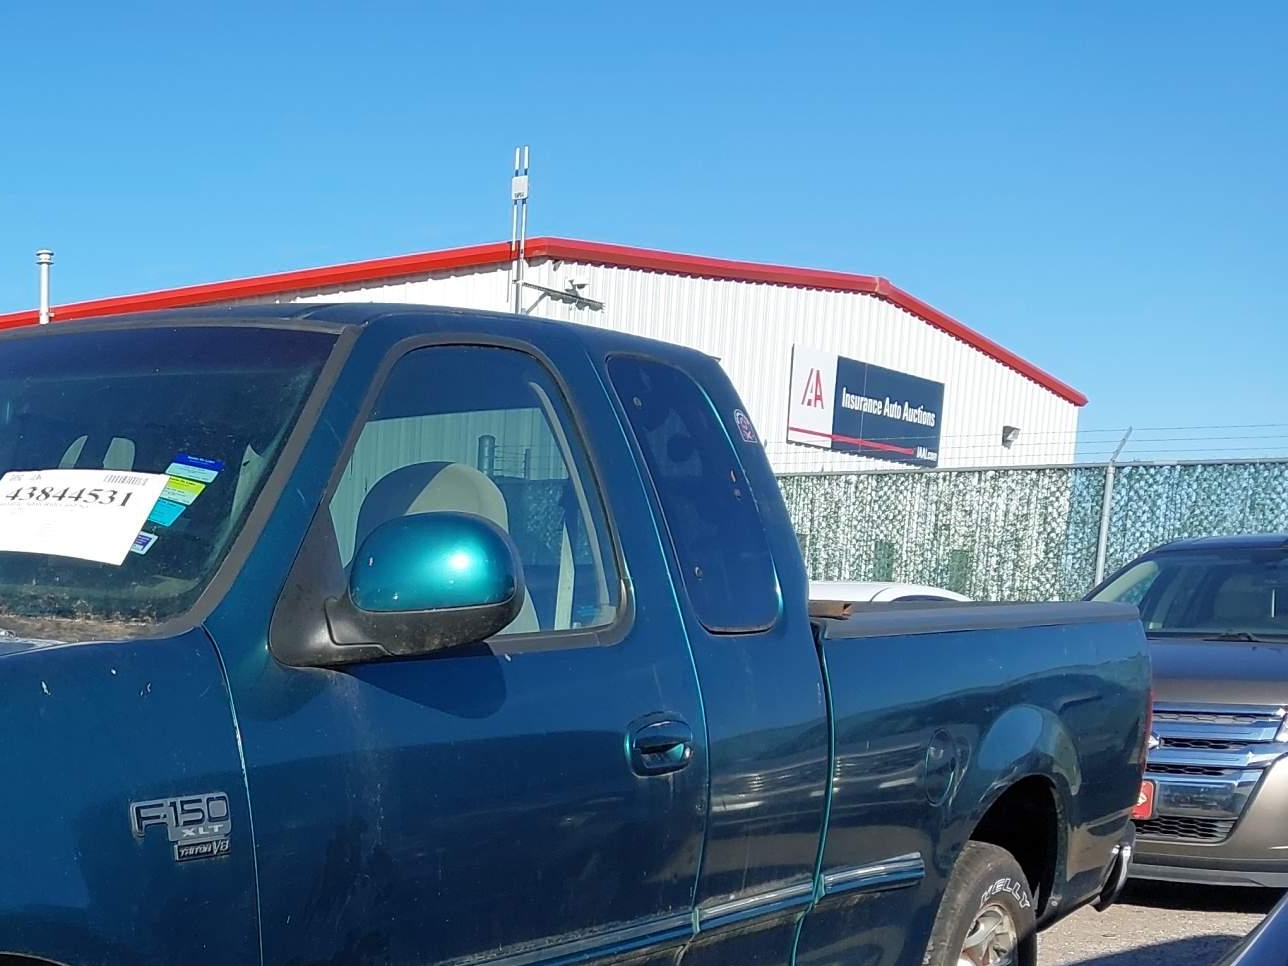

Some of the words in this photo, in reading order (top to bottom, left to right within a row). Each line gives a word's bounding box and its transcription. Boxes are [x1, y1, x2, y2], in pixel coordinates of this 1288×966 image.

[841, 386, 882, 416] Insurance
[883, 397, 902, 420] Auto
[902, 401, 936, 427] Auctions
[5, 486, 134, 508] 43844531
[181, 824, 224, 837] XLT
[979, 877, 1031, 909] KELLY
